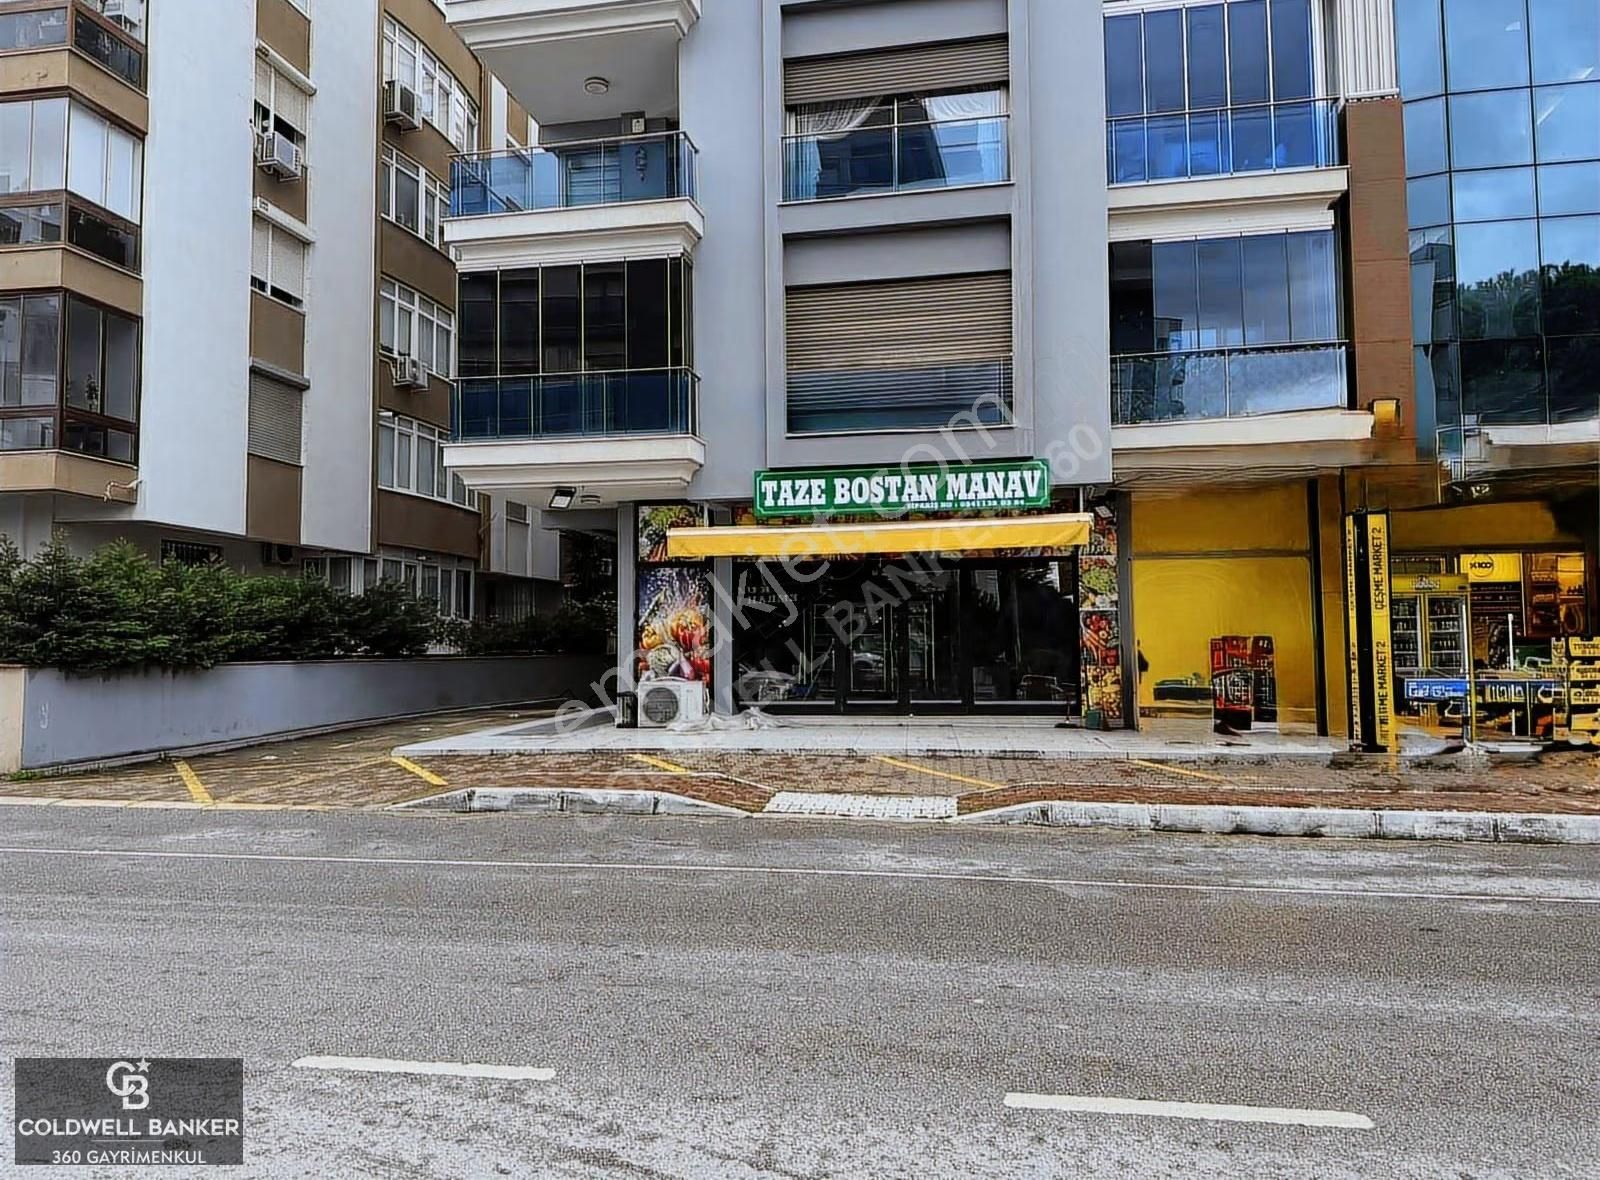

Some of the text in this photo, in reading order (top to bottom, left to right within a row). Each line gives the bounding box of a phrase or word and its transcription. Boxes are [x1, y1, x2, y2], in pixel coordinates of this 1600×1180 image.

[761, 470, 1042, 506] TAZE BOSTAN MANAV
[1371, 526, 1381, 534] 2
[1372, 535, 1383, 576] MARKET
[1376, 641, 1386, 649] 2
[1376, 650, 1388, 690] MARKET
